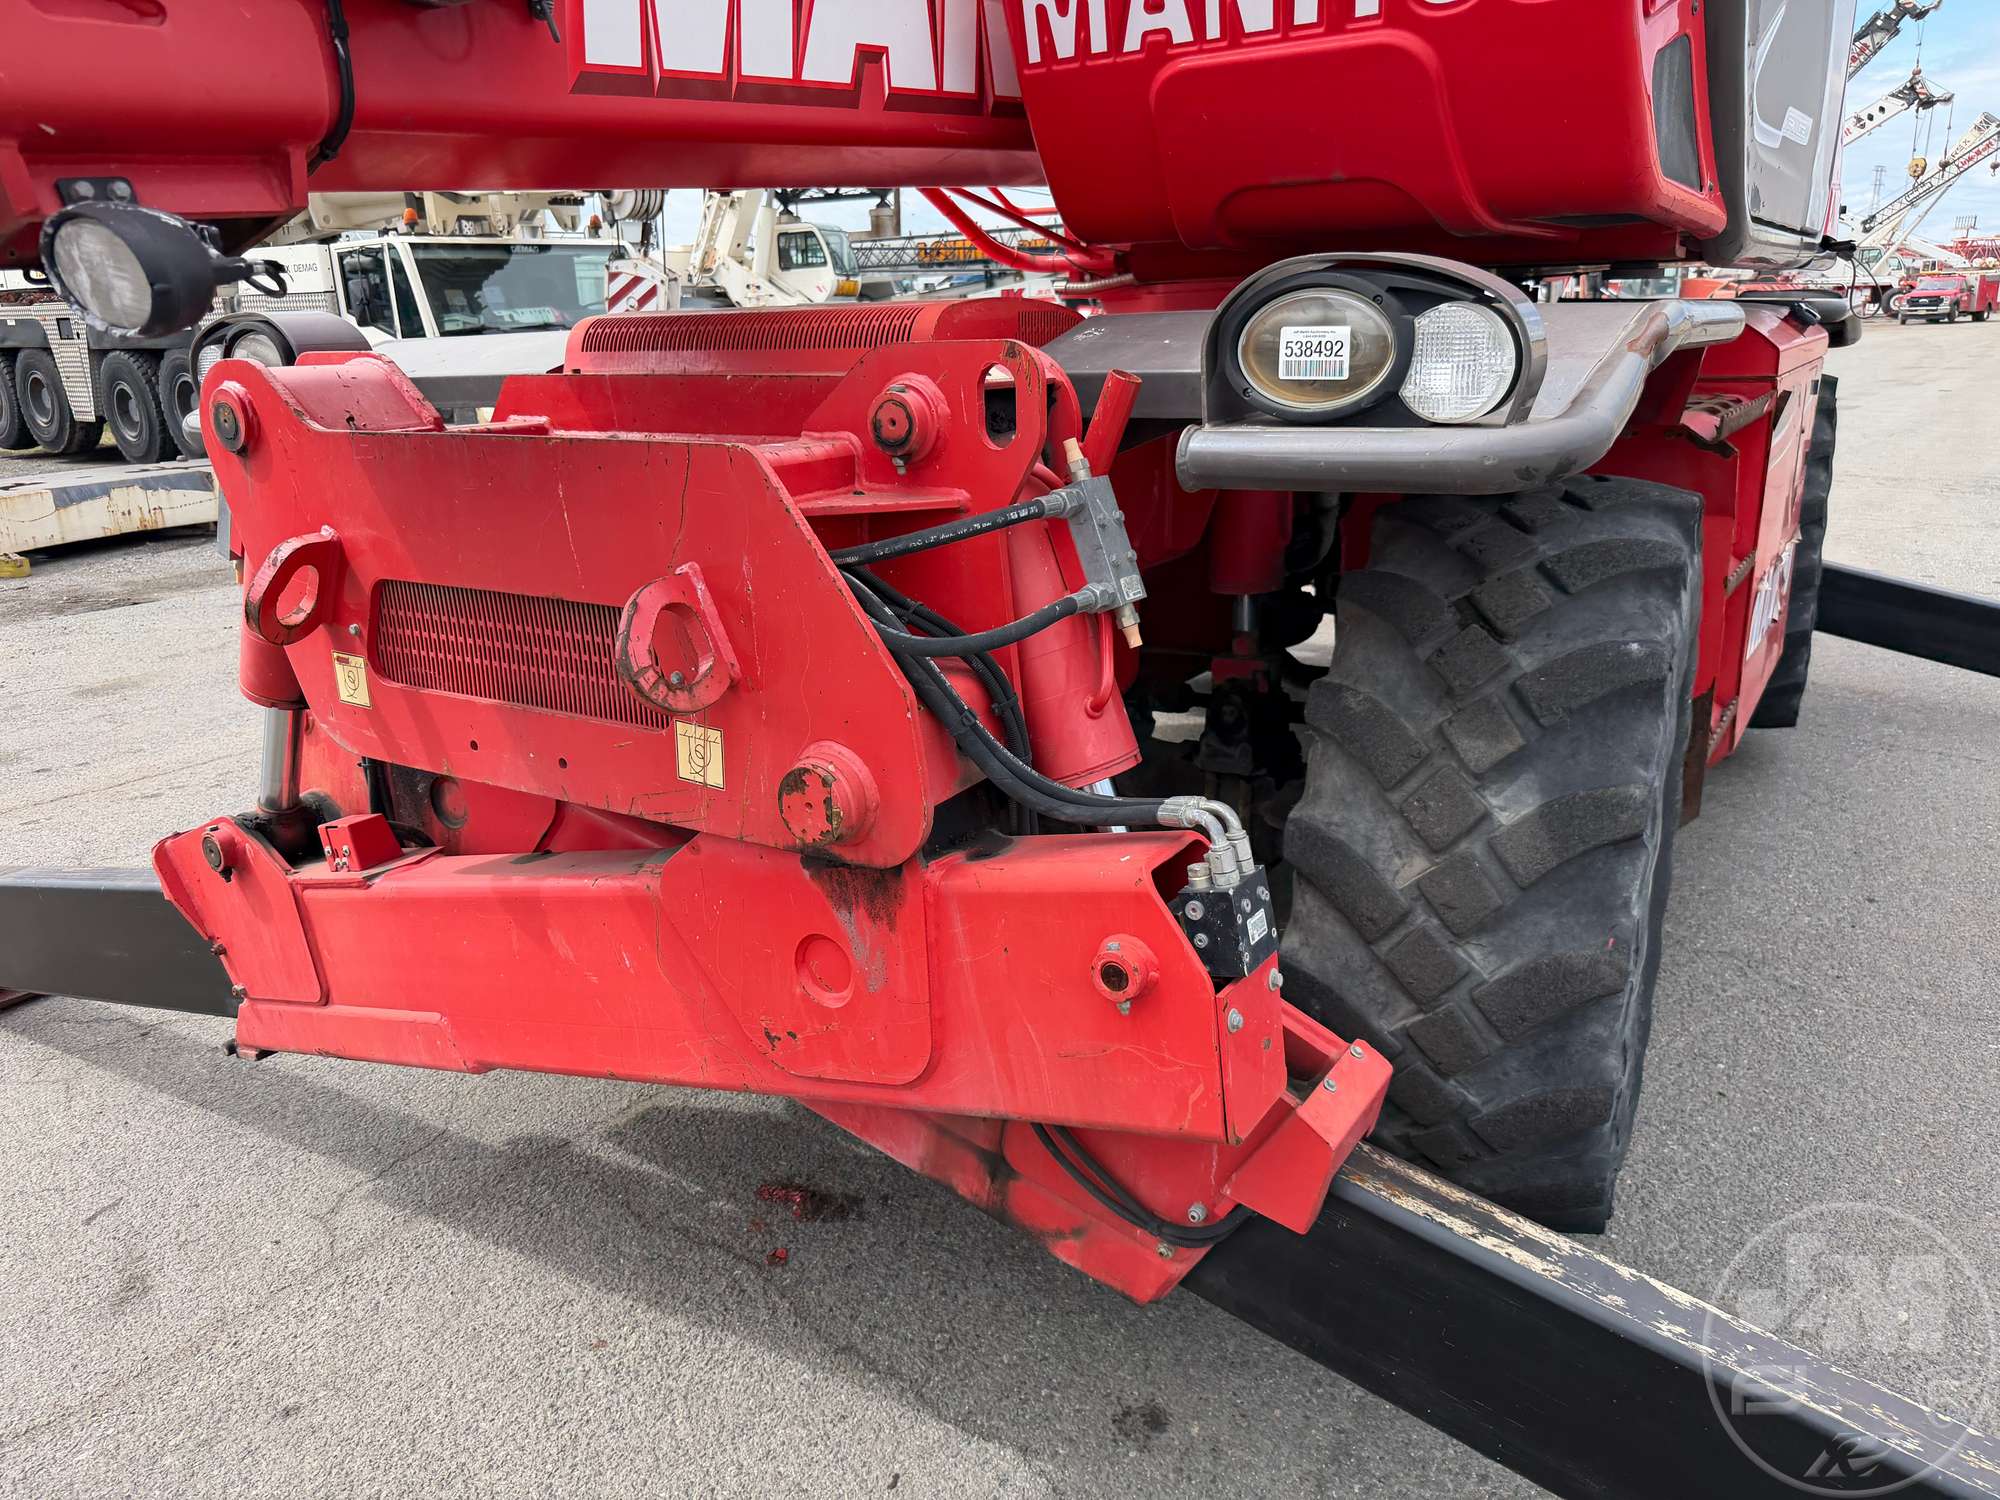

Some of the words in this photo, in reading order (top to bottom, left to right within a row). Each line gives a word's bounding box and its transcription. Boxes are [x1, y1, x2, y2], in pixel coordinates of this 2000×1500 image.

[1022, 0, 1458, 64] MAN
[294, 263, 318, 272] DEMAG
[1284, 340, 1344, 358] 538492
